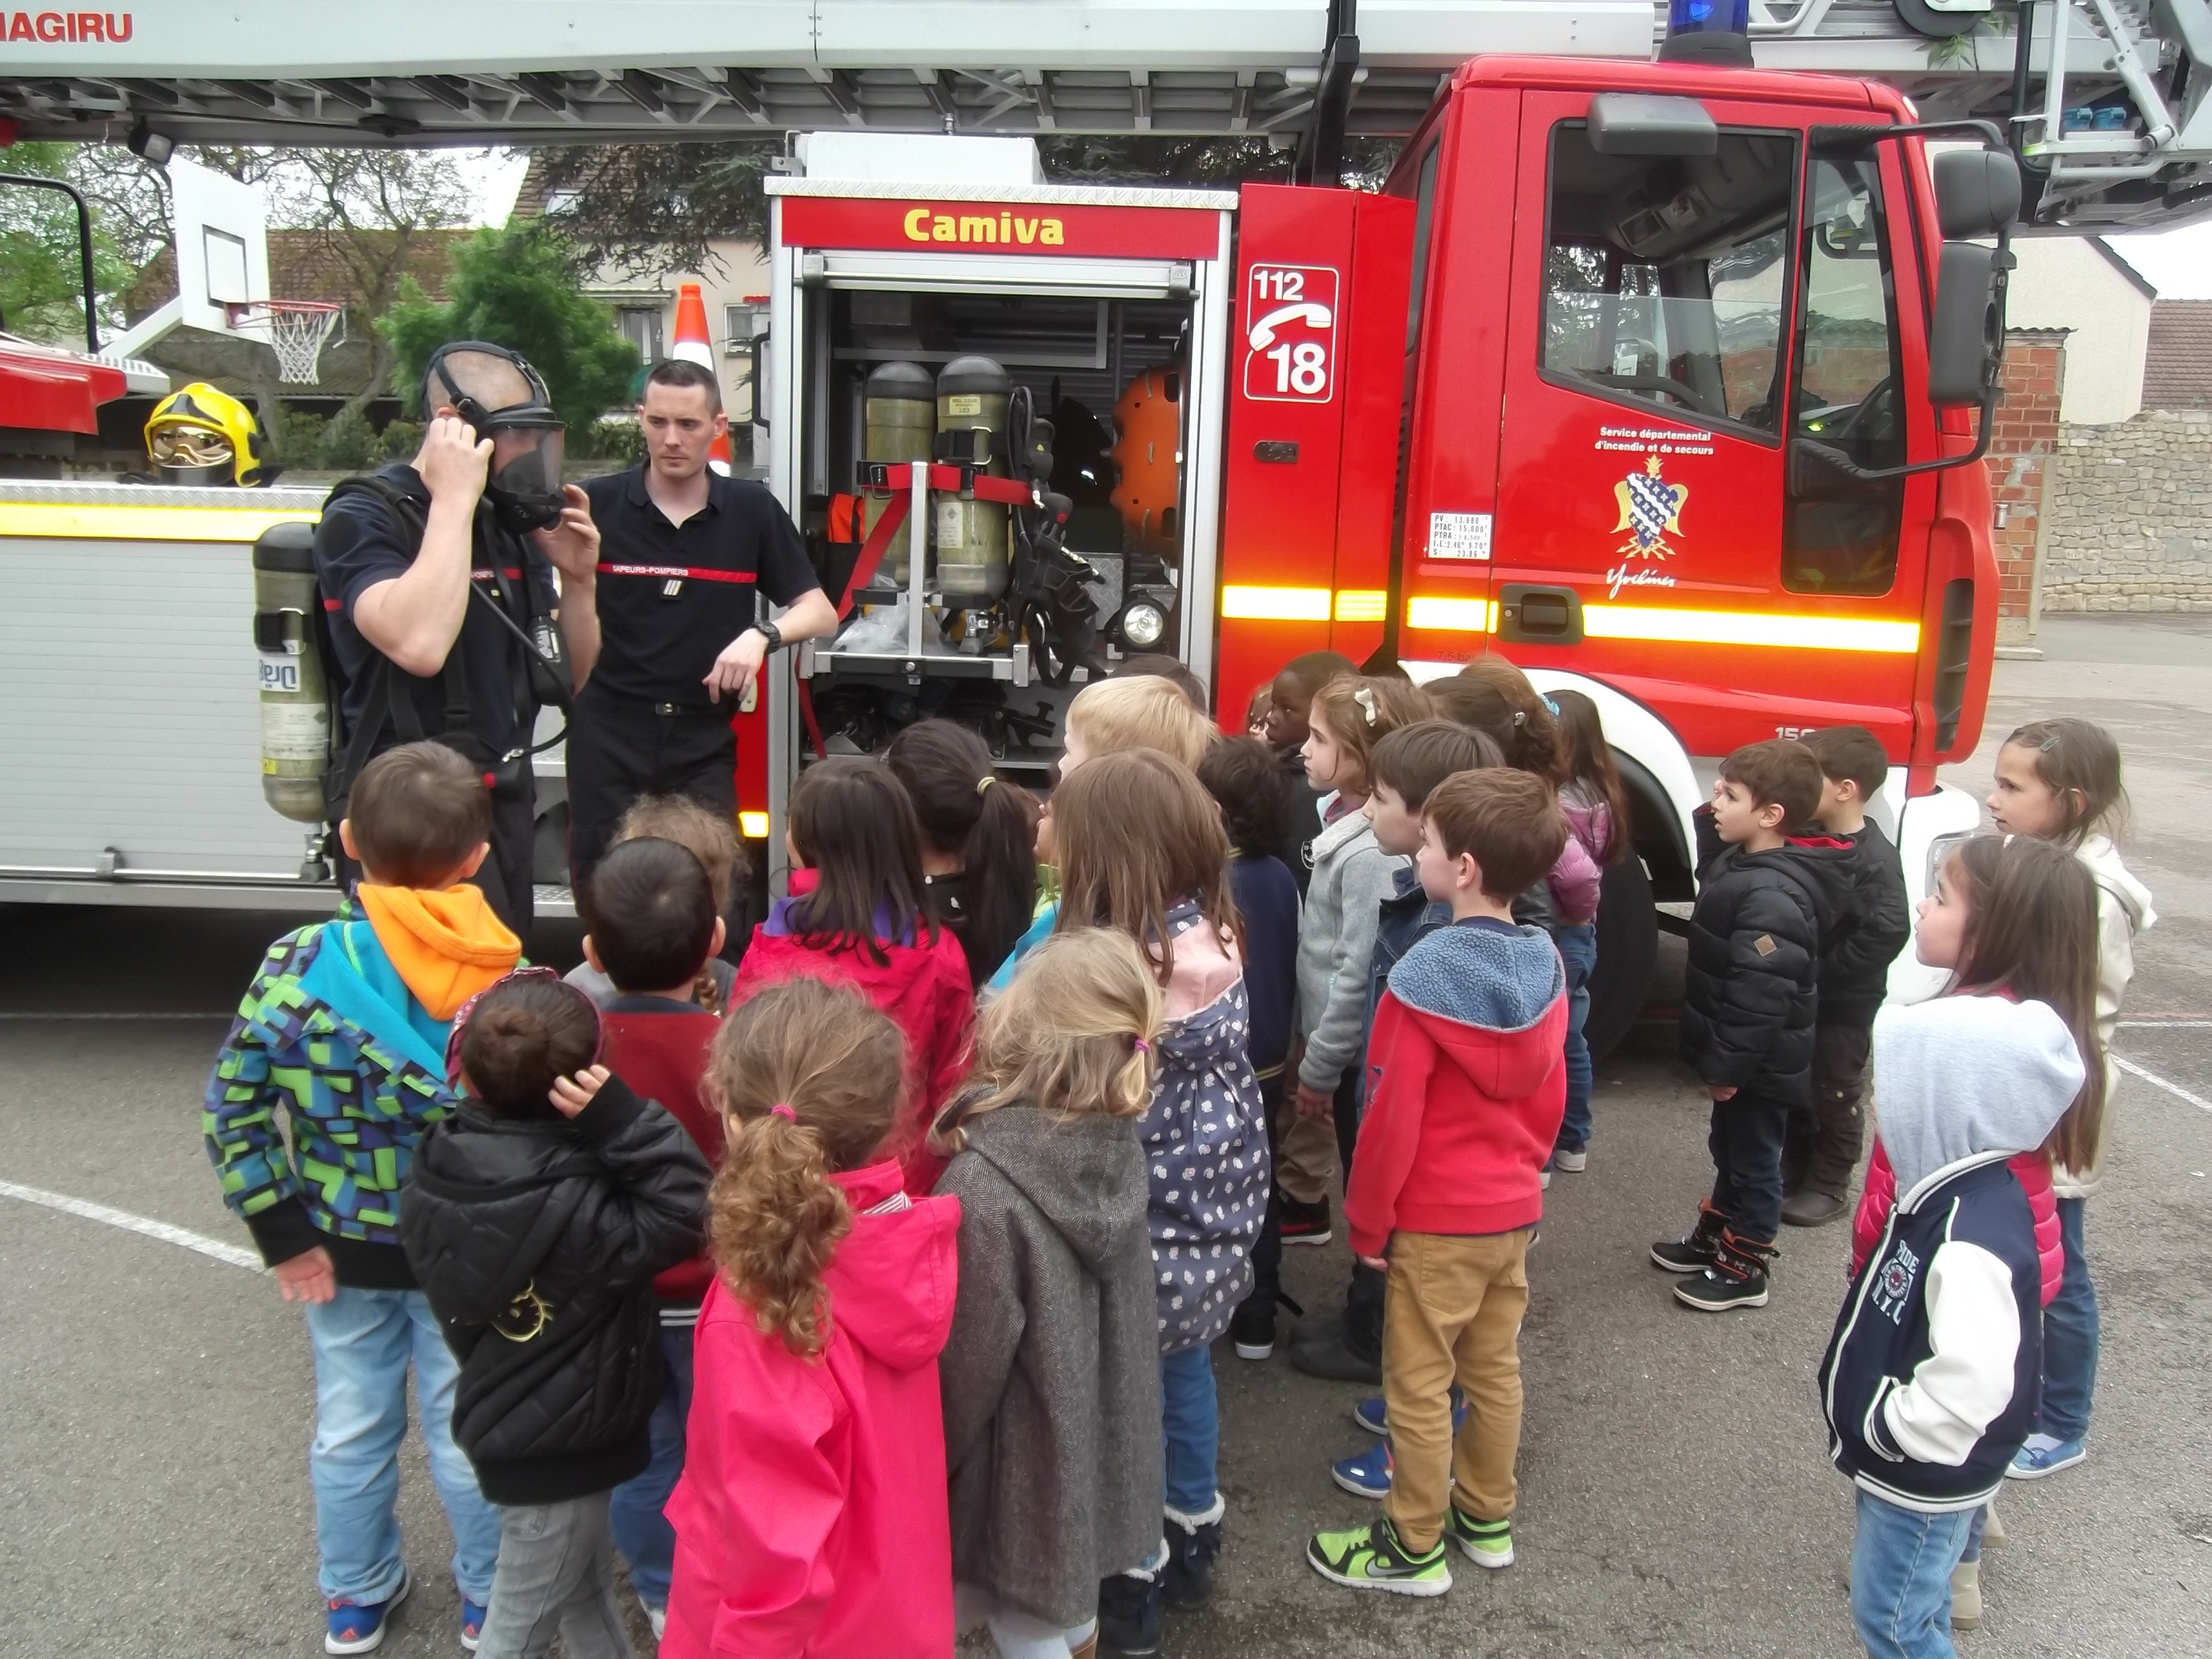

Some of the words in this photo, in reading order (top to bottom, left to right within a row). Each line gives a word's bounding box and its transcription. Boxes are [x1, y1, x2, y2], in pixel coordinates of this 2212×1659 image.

[0, 12, 133, 42] AGIRU
[904, 209, 1064, 245] Camiva
[1254, 270, 1304, 301] 112
[1267, 343, 1326, 394] 18
[1594, 441, 1645, 452] d'incendie
[1660, 444, 1672, 453] de
[1675, 446, 1714, 455] secours
[1600, 426, 1637, 438] Service
[1640, 429, 1712, 441] départemental
[1606, 563, 1676, 600] Yvelines
